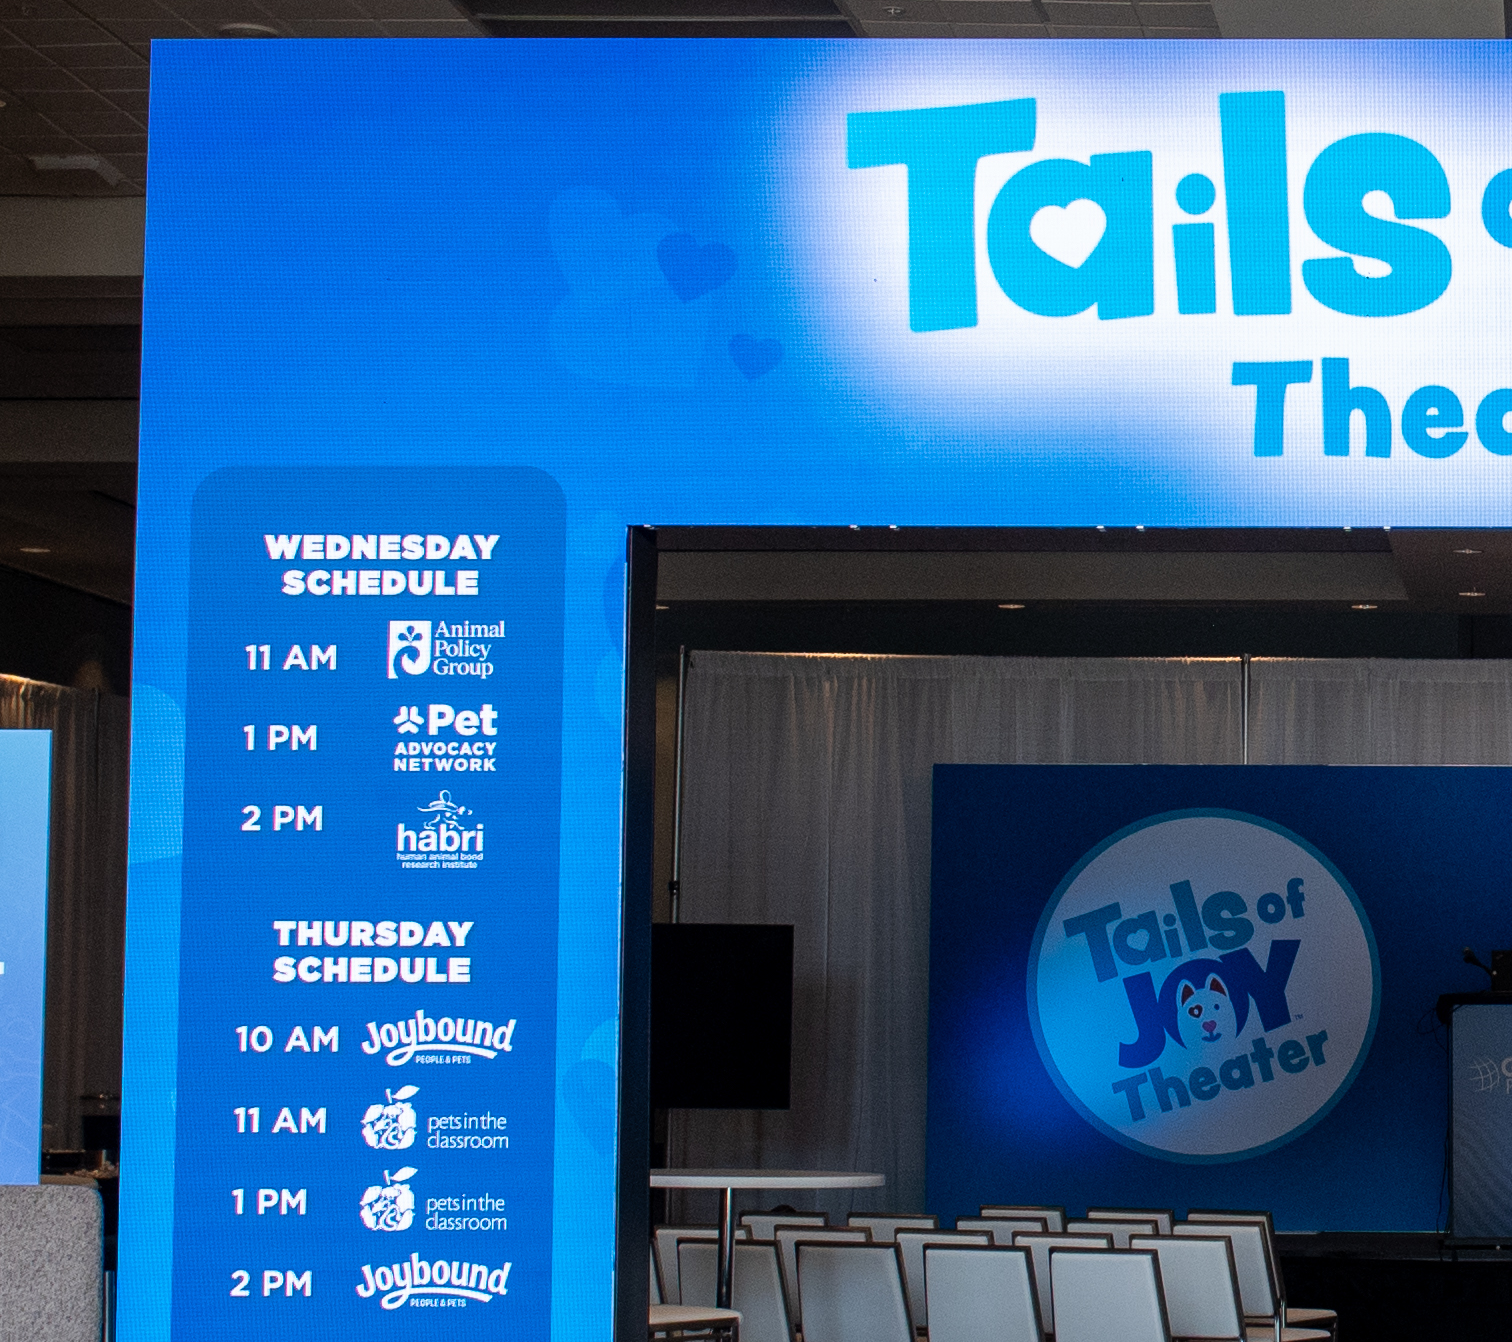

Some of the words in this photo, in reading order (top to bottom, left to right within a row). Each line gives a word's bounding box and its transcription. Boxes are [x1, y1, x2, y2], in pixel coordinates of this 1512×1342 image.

[845, 90, 1454, 333] Tails
[264, 535, 499, 559] WEDNESDAY
[282, 570, 478, 595] SCHEDULE
[436, 621, 505, 637] Animal
[246, 645, 270, 670] 11
[283, 645, 336, 670] AM
[435, 640, 491, 661] Policy
[433, 657, 493, 678] Group
[428, 704, 497, 735] Pet
[244, 725, 254, 750] 1
[268, 725, 316, 750] PM
[395, 742, 496, 755] ADVOCACY
[394, 758, 495, 771] NETWORK
[242, 806, 260, 830] 2
[273, 806, 322, 830] PM
[398, 823, 483, 851] habri
[273, 921, 474, 946] THURSDAY
[1063, 879, 1255, 983] Tails
[1256, 877, 1306, 925] of
[273, 957, 470, 982] SCHEDULE
[1118, 939, 1301, 1070] JOY
[236, 1026, 272, 1052] 10
[285, 1026, 338, 1052] AM
[362, 1010, 516, 1066] Joybound
[1112, 1029, 1329, 1124] Theater
[234, 1108, 259, 1132] 11
[272, 1108, 326, 1133] AM
[428, 1131, 508, 1148] classroom
[232, 1189, 243, 1214] 1
[258, 1189, 306, 1214] PM
[426, 1213, 506, 1230] classroom
[230, 1270, 249, 1296] 2
[263, 1271, 311, 1296] PM
[356, 1253, 511, 1309] Joybound
